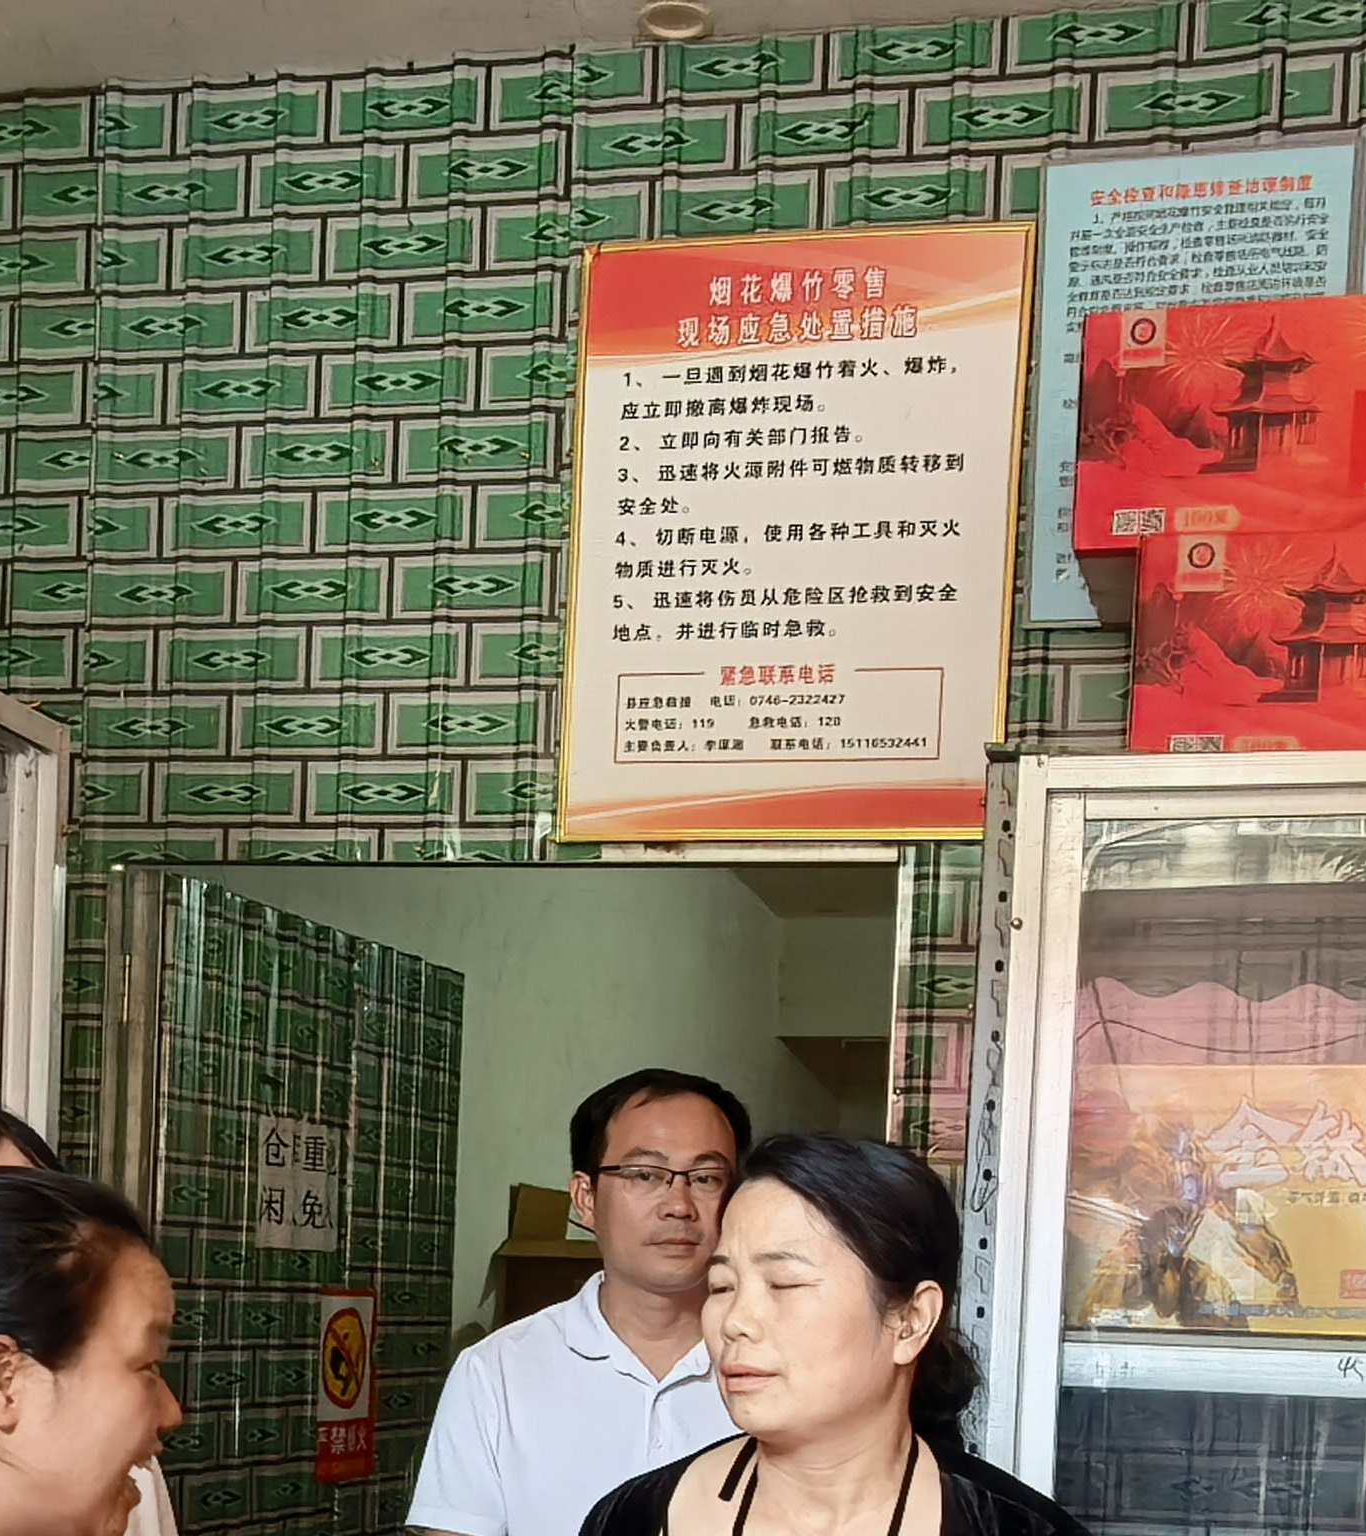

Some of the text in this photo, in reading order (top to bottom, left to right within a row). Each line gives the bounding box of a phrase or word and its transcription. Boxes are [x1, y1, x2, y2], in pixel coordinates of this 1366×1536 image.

[709, 266, 888, 307] 烟花爆竹零售
[677, 304, 920, 348] 现场应急处置措施
[617, 497, 692, 517] 安全处。
[614, 558, 755, 579] 物质进行灭火。
[719, 663, 837, 687] 紧急联系电话
